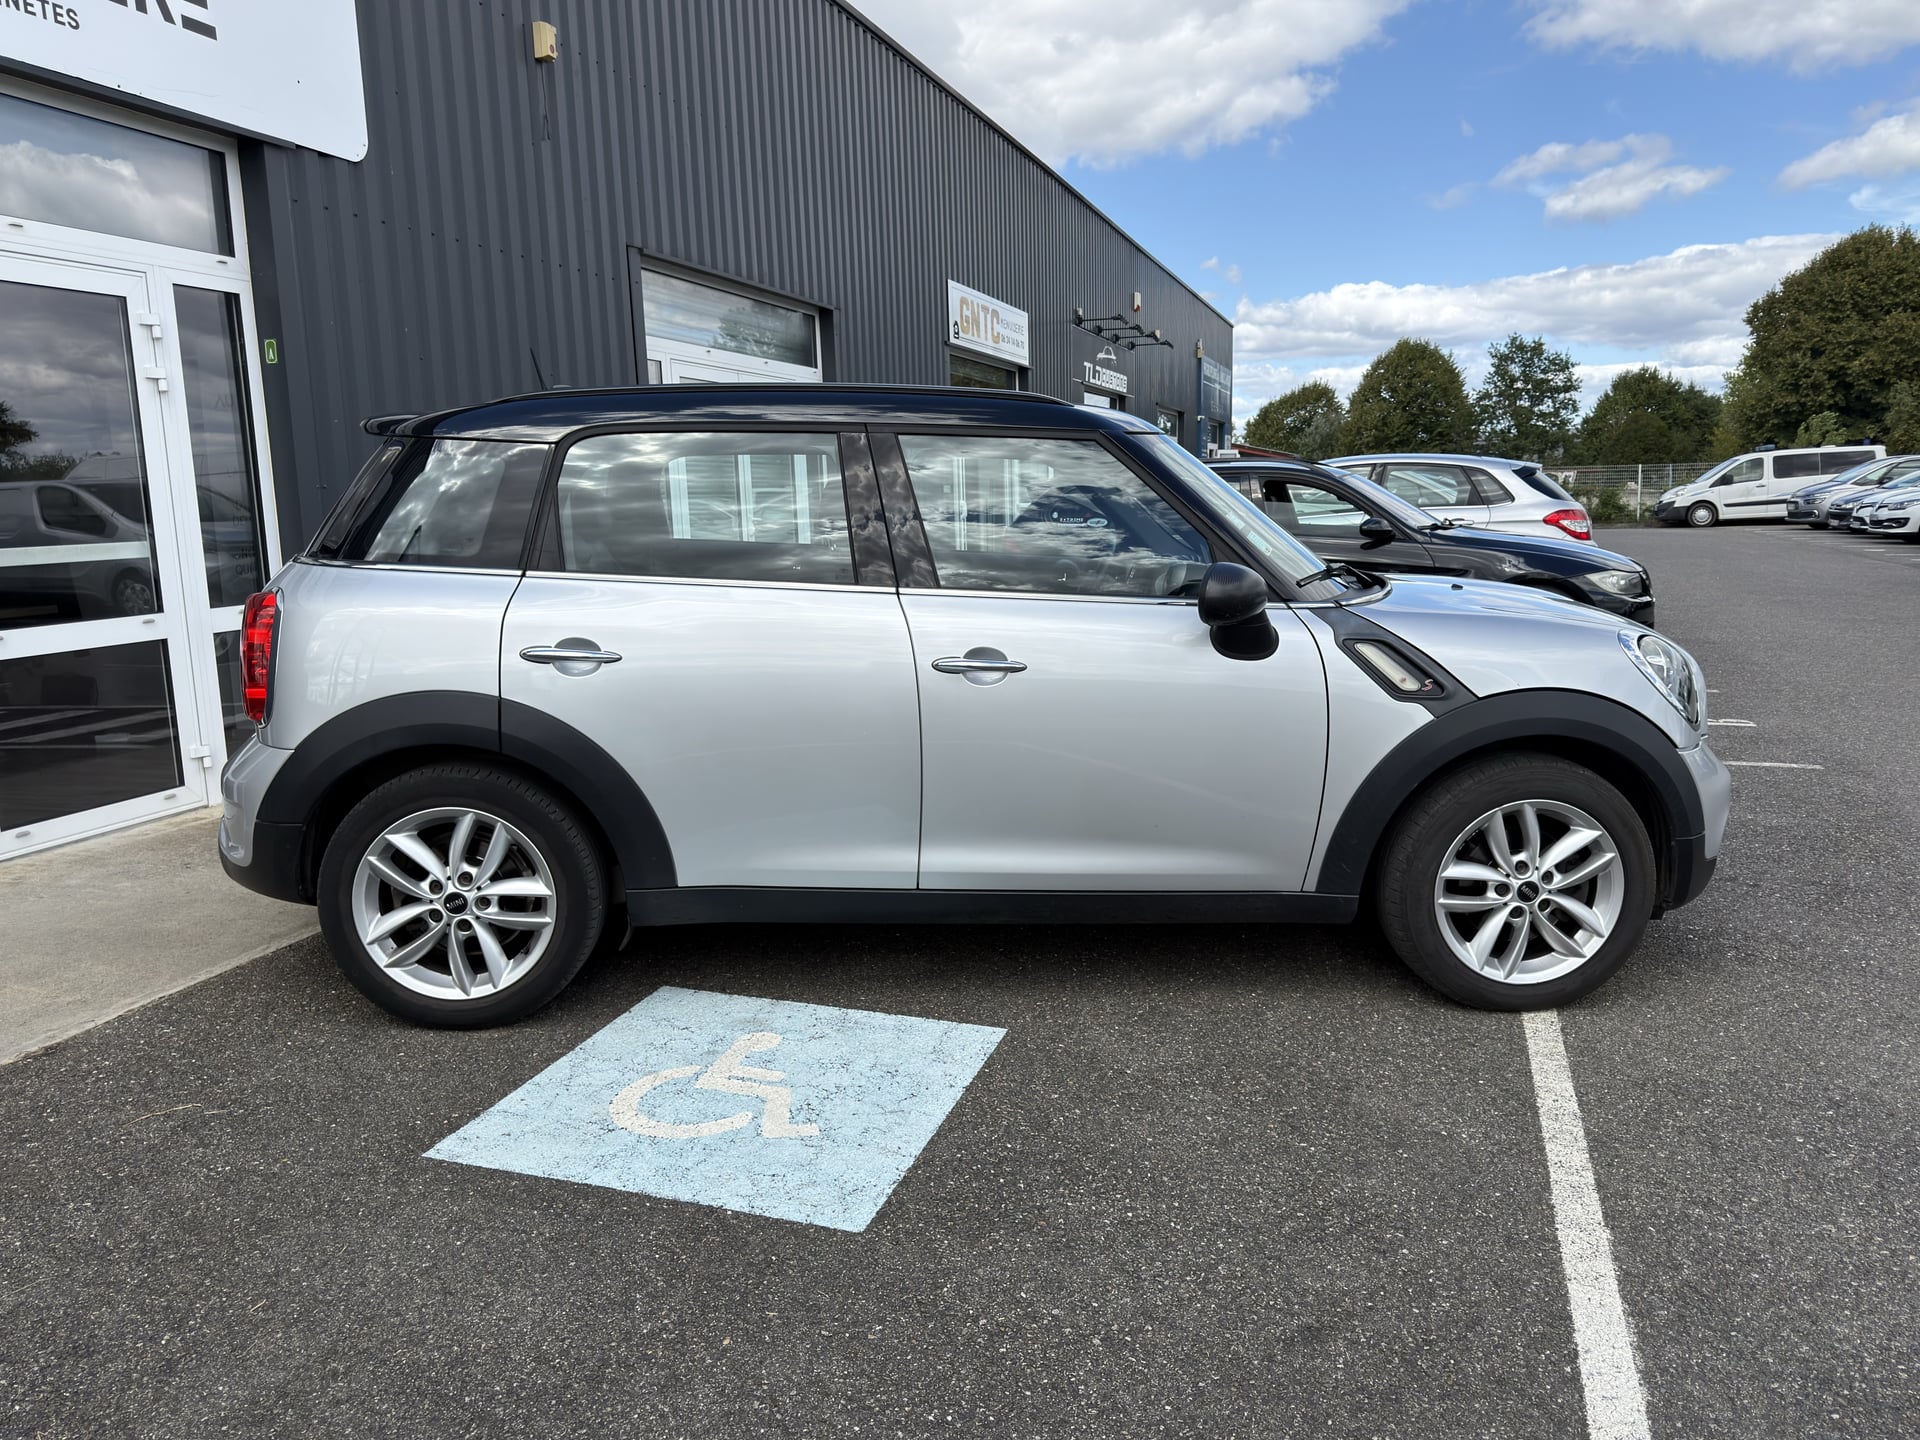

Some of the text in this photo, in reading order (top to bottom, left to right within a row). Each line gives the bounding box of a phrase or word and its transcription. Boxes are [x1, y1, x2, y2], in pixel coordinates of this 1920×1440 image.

[0, 0, 80, 30] NETES
[959, 296, 1000, 345] GNTC
[1421, 678, 1434, 692] S
[1520, 885, 1536, 899] MINI
[446, 897, 465, 910] MINI
